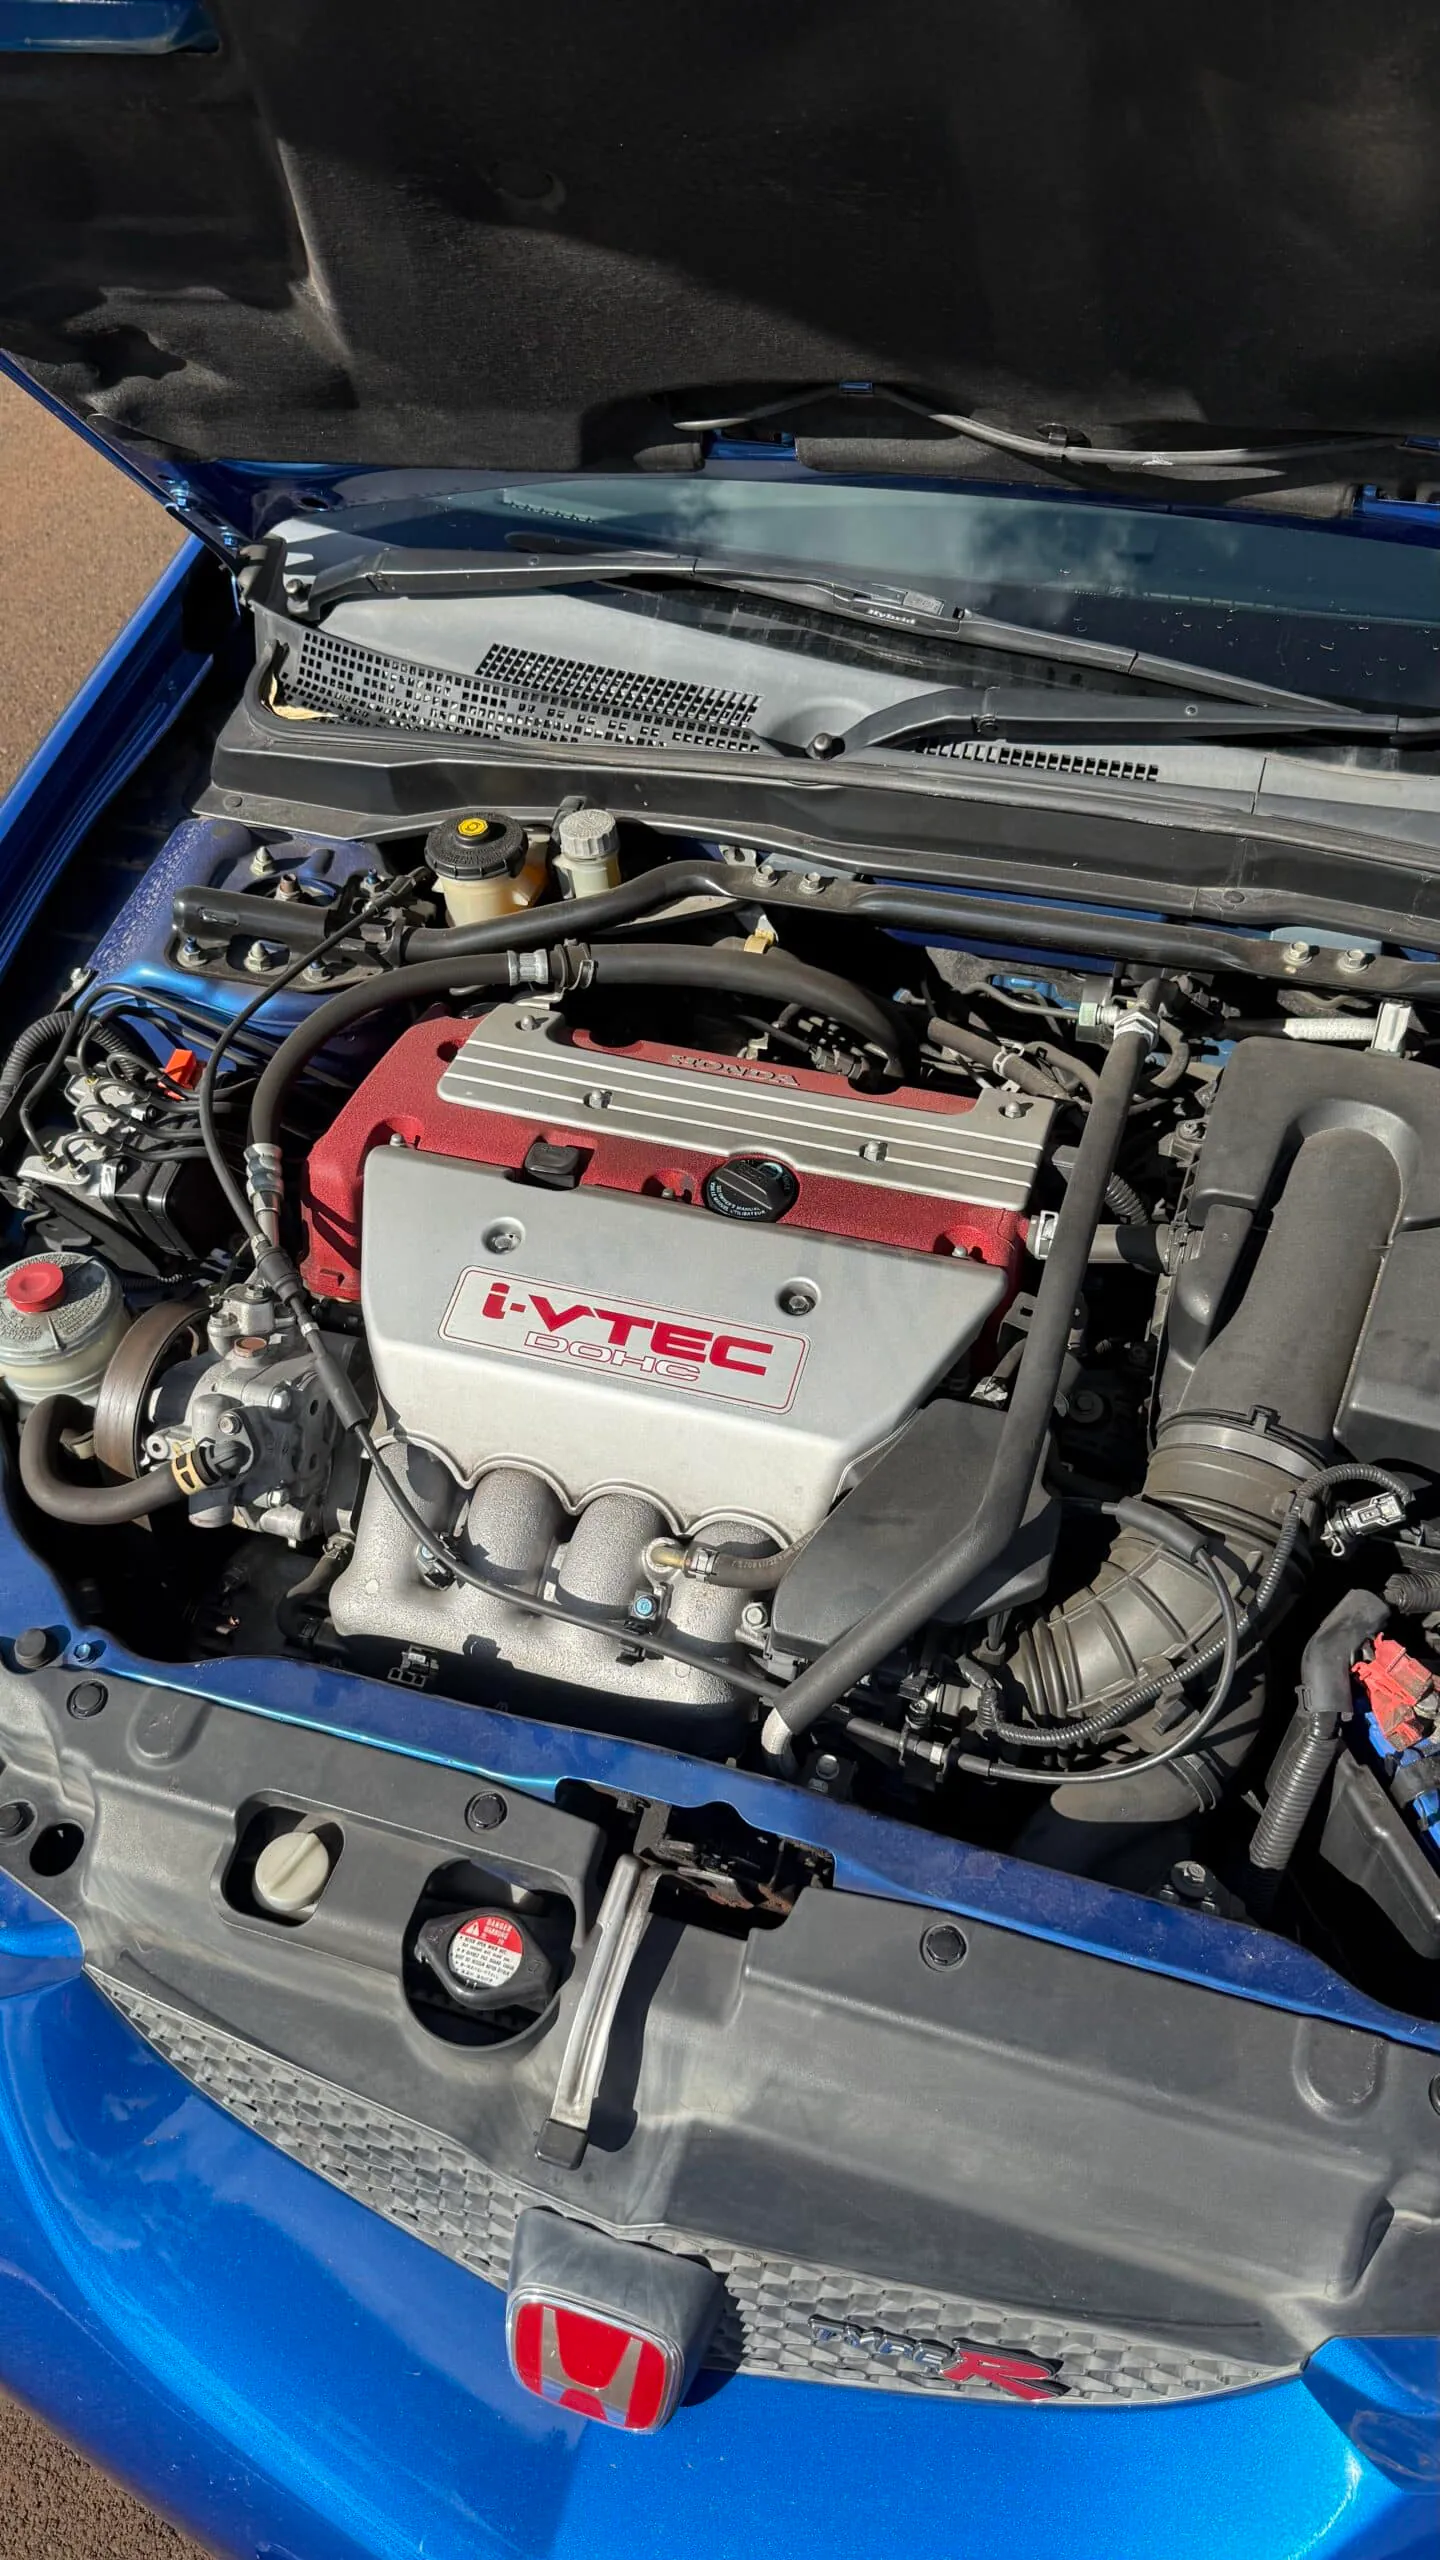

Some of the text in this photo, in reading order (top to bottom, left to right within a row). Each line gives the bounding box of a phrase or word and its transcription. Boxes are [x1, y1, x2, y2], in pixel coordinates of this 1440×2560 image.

[867, 608, 916, 625] Hybrid
[671, 1054, 801, 1086] HONDA
[482, 1282, 774, 1376] i-VTEC
[523, 1331, 701, 1382] DOHC
[486, 1918, 513, 1932] DANGER
[939, 2337, 1070, 2402] R
